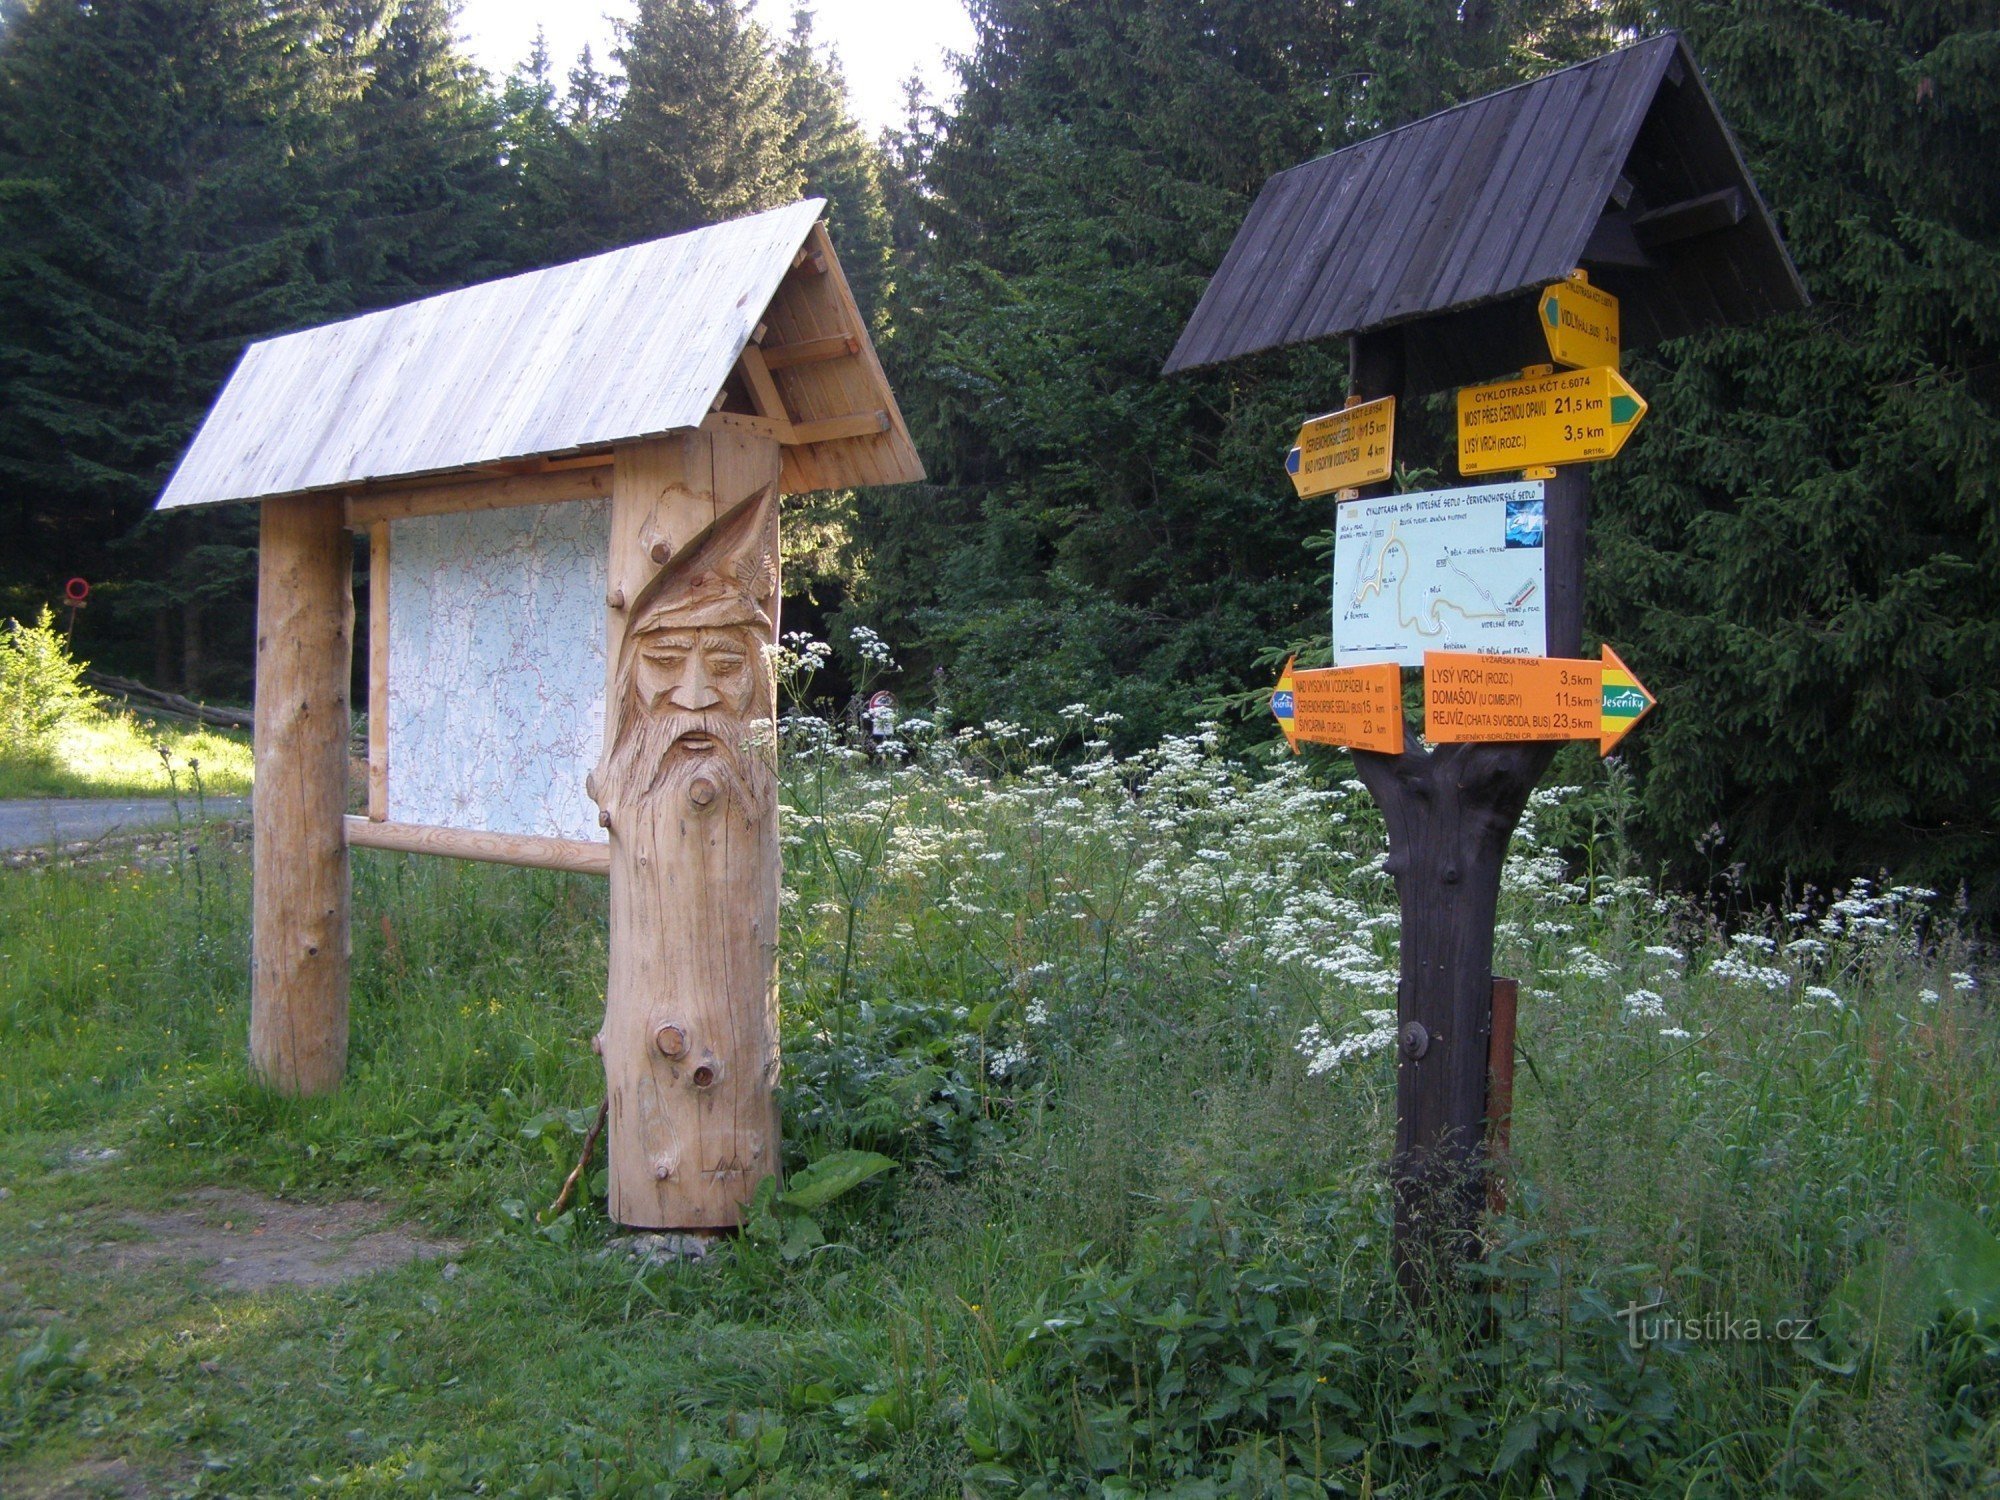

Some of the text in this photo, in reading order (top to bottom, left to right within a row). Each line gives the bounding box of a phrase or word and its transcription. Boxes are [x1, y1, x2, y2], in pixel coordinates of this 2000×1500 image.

[1475, 385, 1537, 403] CYKLOTRASA
[1561, 376, 1590, 389] č.6074
[1464, 396, 1603, 427] MOST PŘES ČERNOU OPAVU 21,5 km
[1365, 420, 1375, 436] 15
[1376, 423, 1386, 433] km
[1464, 424, 1604, 454] LYSÝ VRCH (ROZC.) 3,5 km
[1367, 443, 1373, 458] 4
[1374, 446, 1385, 457] km
[1365, 504, 1398, 516] CYKLOTRASA
[1443, 497, 1461, 508] SEDLO
[1466, 490, 1516, 506] ČERVENOHORSKÉ
[1518, 490, 1535, 500] SEDLO
[1517, 658, 1540, 667] TRASA
[1432, 666, 1455, 684] LYSÝ
[1457, 669, 1483, 684] VRCH
[1485, 672, 1513, 686] (ROZC.)
[1296, 680, 1306, 693] NAD
[1365, 680, 1370, 693] 4
[1375, 684, 1384, 693] km
[1363, 700, 1371, 713] 15
[1376, 704, 1385, 713] km
[1432, 687, 1477, 705] DOMAŠOV
[1488, 693, 1522, 708] CIMBURY)
[1602, 695, 1644, 711] Jeseníky
[1363, 719, 1372, 734] 23
[1377, 725, 1386, 734] km
[1432, 708, 1464, 725] REJVÍZ
[1464, 714, 1491, 728] (CHATA
[1532, 715, 1550, 730] BUS)
